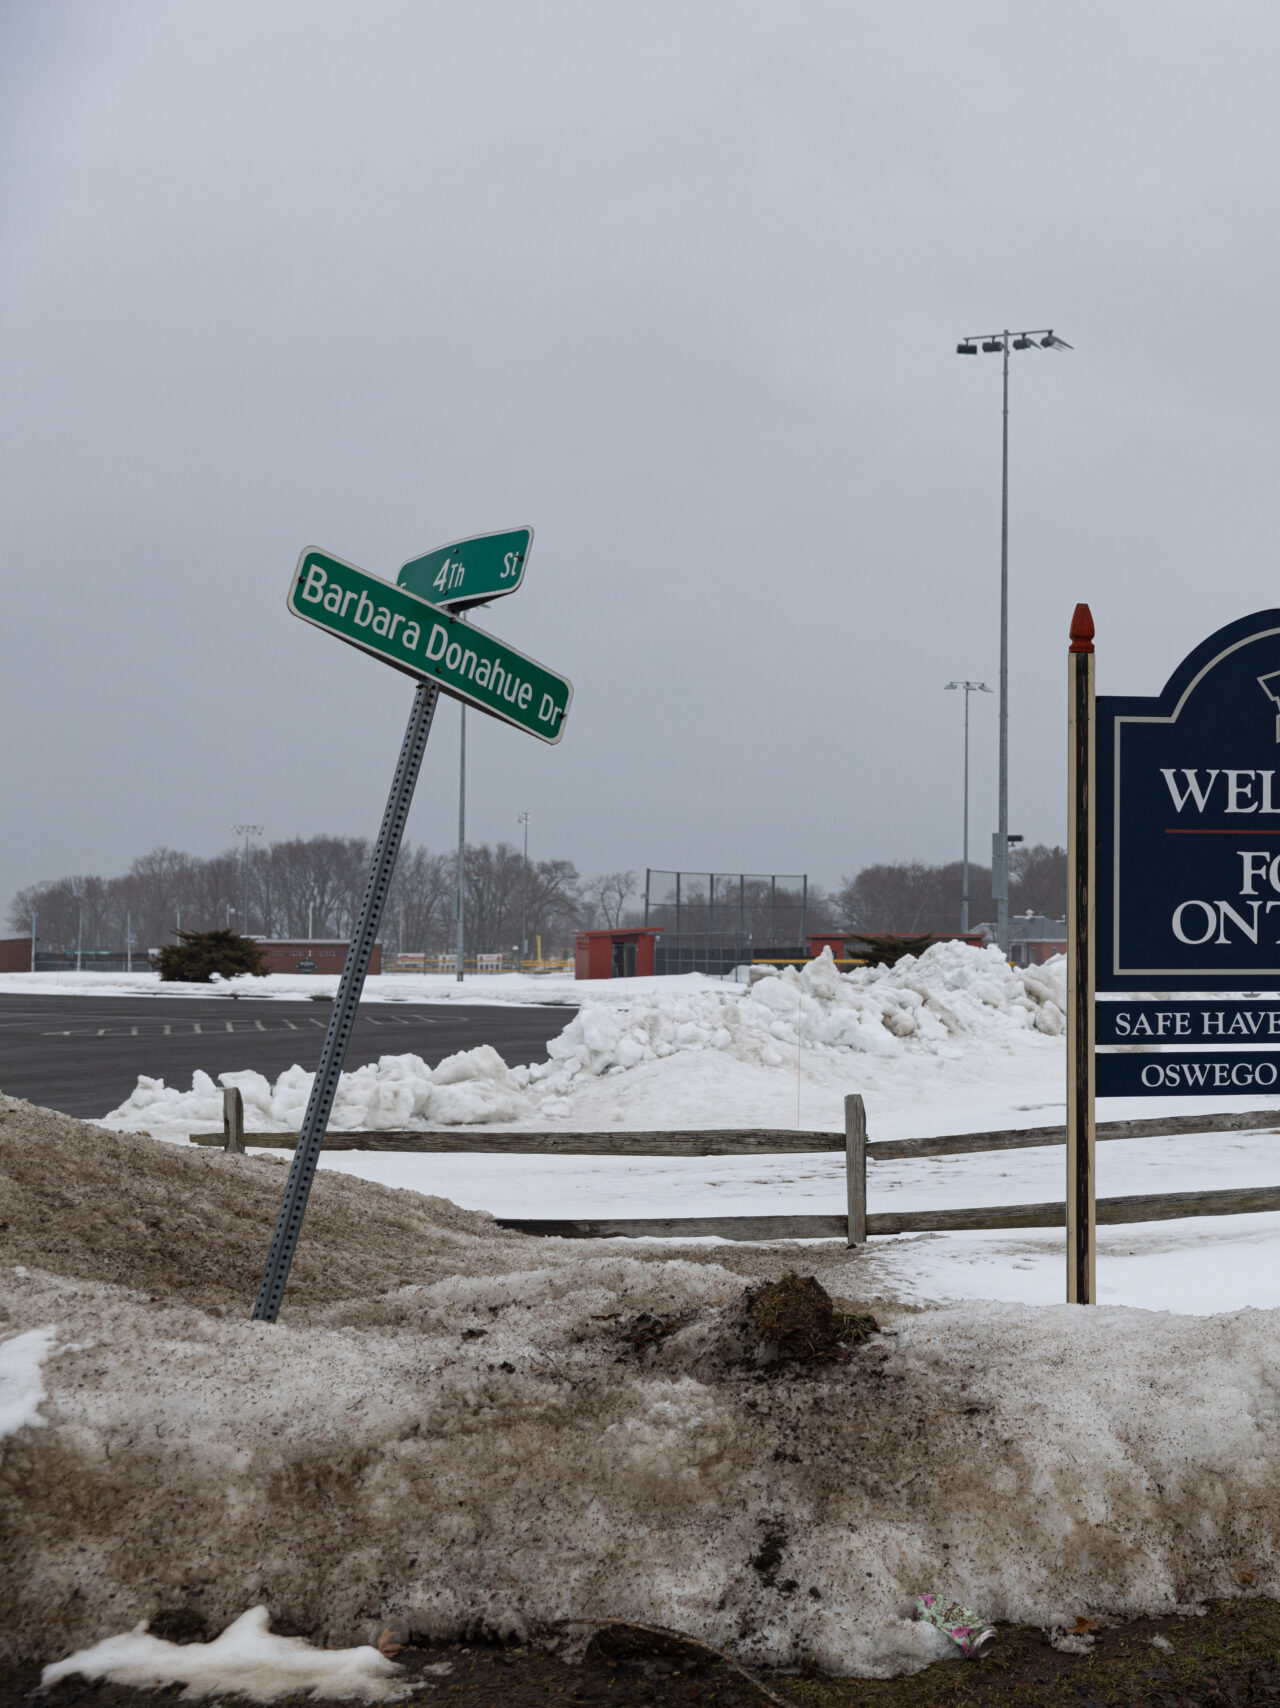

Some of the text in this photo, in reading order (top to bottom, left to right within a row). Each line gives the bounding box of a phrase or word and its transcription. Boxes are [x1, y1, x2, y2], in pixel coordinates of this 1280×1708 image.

[499, 552, 519, 578] St
[301, 563, 563, 726] Barbara Donahue Dr
[1115, 1012, 1192, 1036] SAFE
[1141, 1062, 1278, 1088] OSWEGO
